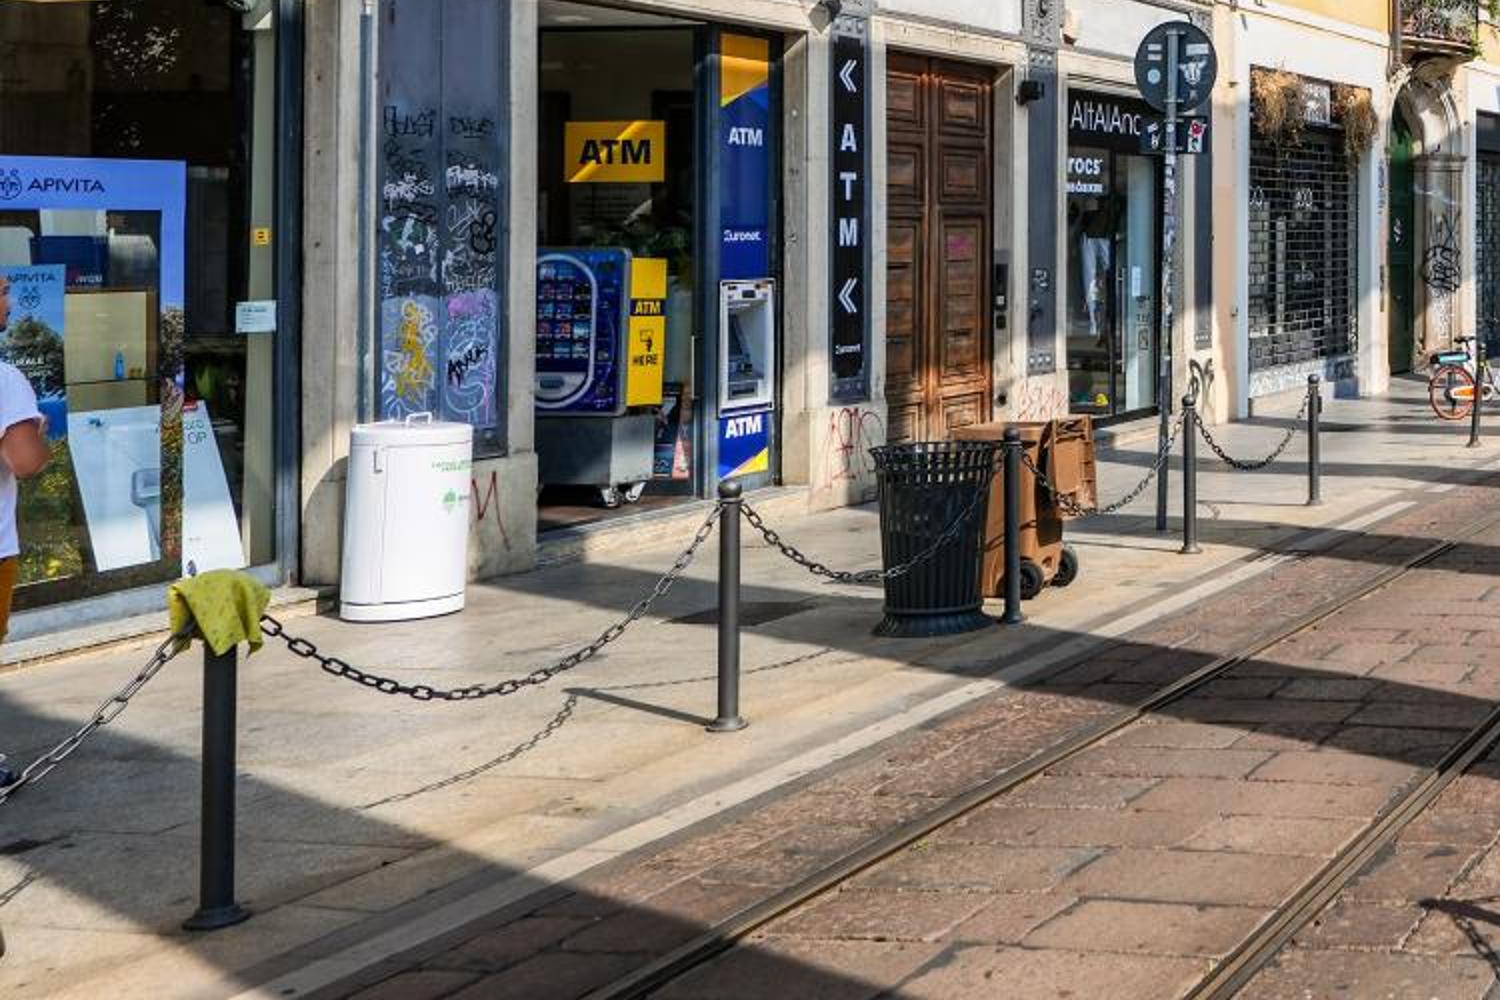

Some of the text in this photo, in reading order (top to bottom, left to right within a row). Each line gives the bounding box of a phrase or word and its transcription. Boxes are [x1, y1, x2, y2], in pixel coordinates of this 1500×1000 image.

[728, 127, 764, 147] ATM
[579, 139, 651, 165] ATM
[27, 177, 105, 193] APIVITA
[839, 123, 858, 246] ATM
[635, 301, 661, 315] ATM
[725, 413, 762, 439] ATM
